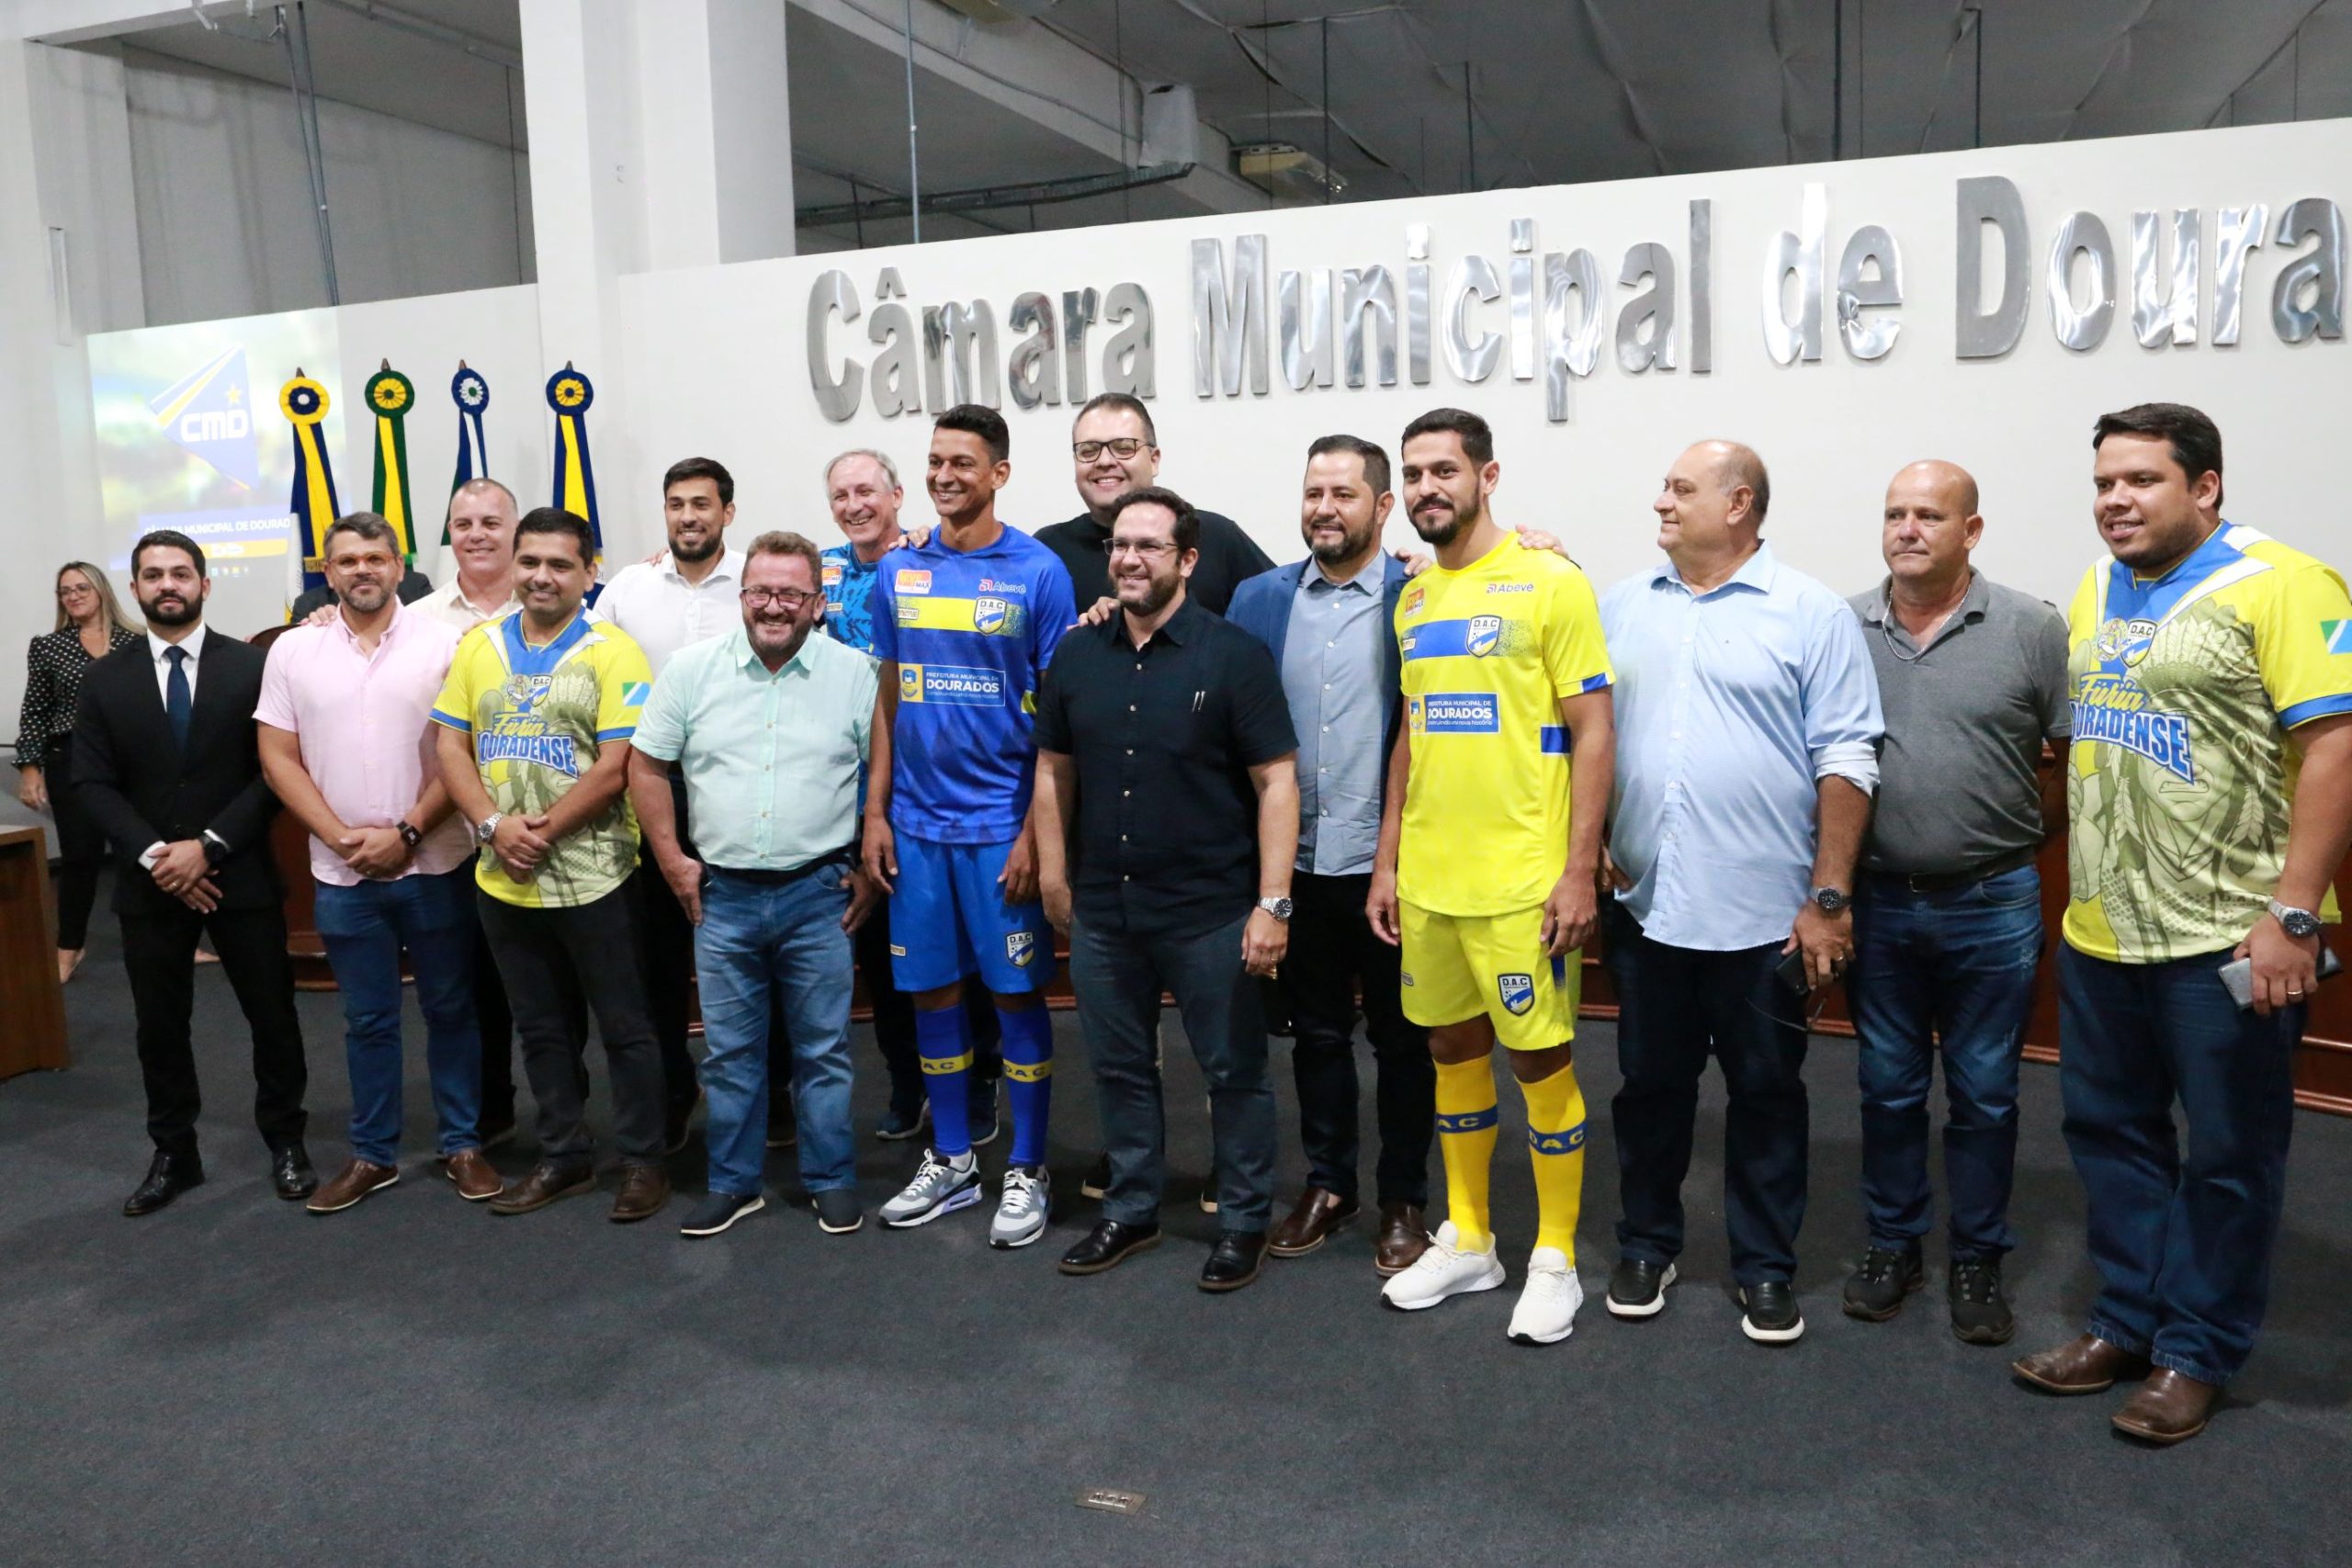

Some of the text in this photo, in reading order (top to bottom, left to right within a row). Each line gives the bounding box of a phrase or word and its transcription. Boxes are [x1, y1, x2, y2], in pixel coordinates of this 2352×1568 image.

[807, 175, 2348, 422] Câmara Municipal de Doura
[181, 410, 249, 442] CMD
[185, 521, 235, 535] MUNICIPAL
[235, 520, 249, 532] DE
[926, 678, 1000, 694] DOURADOS
